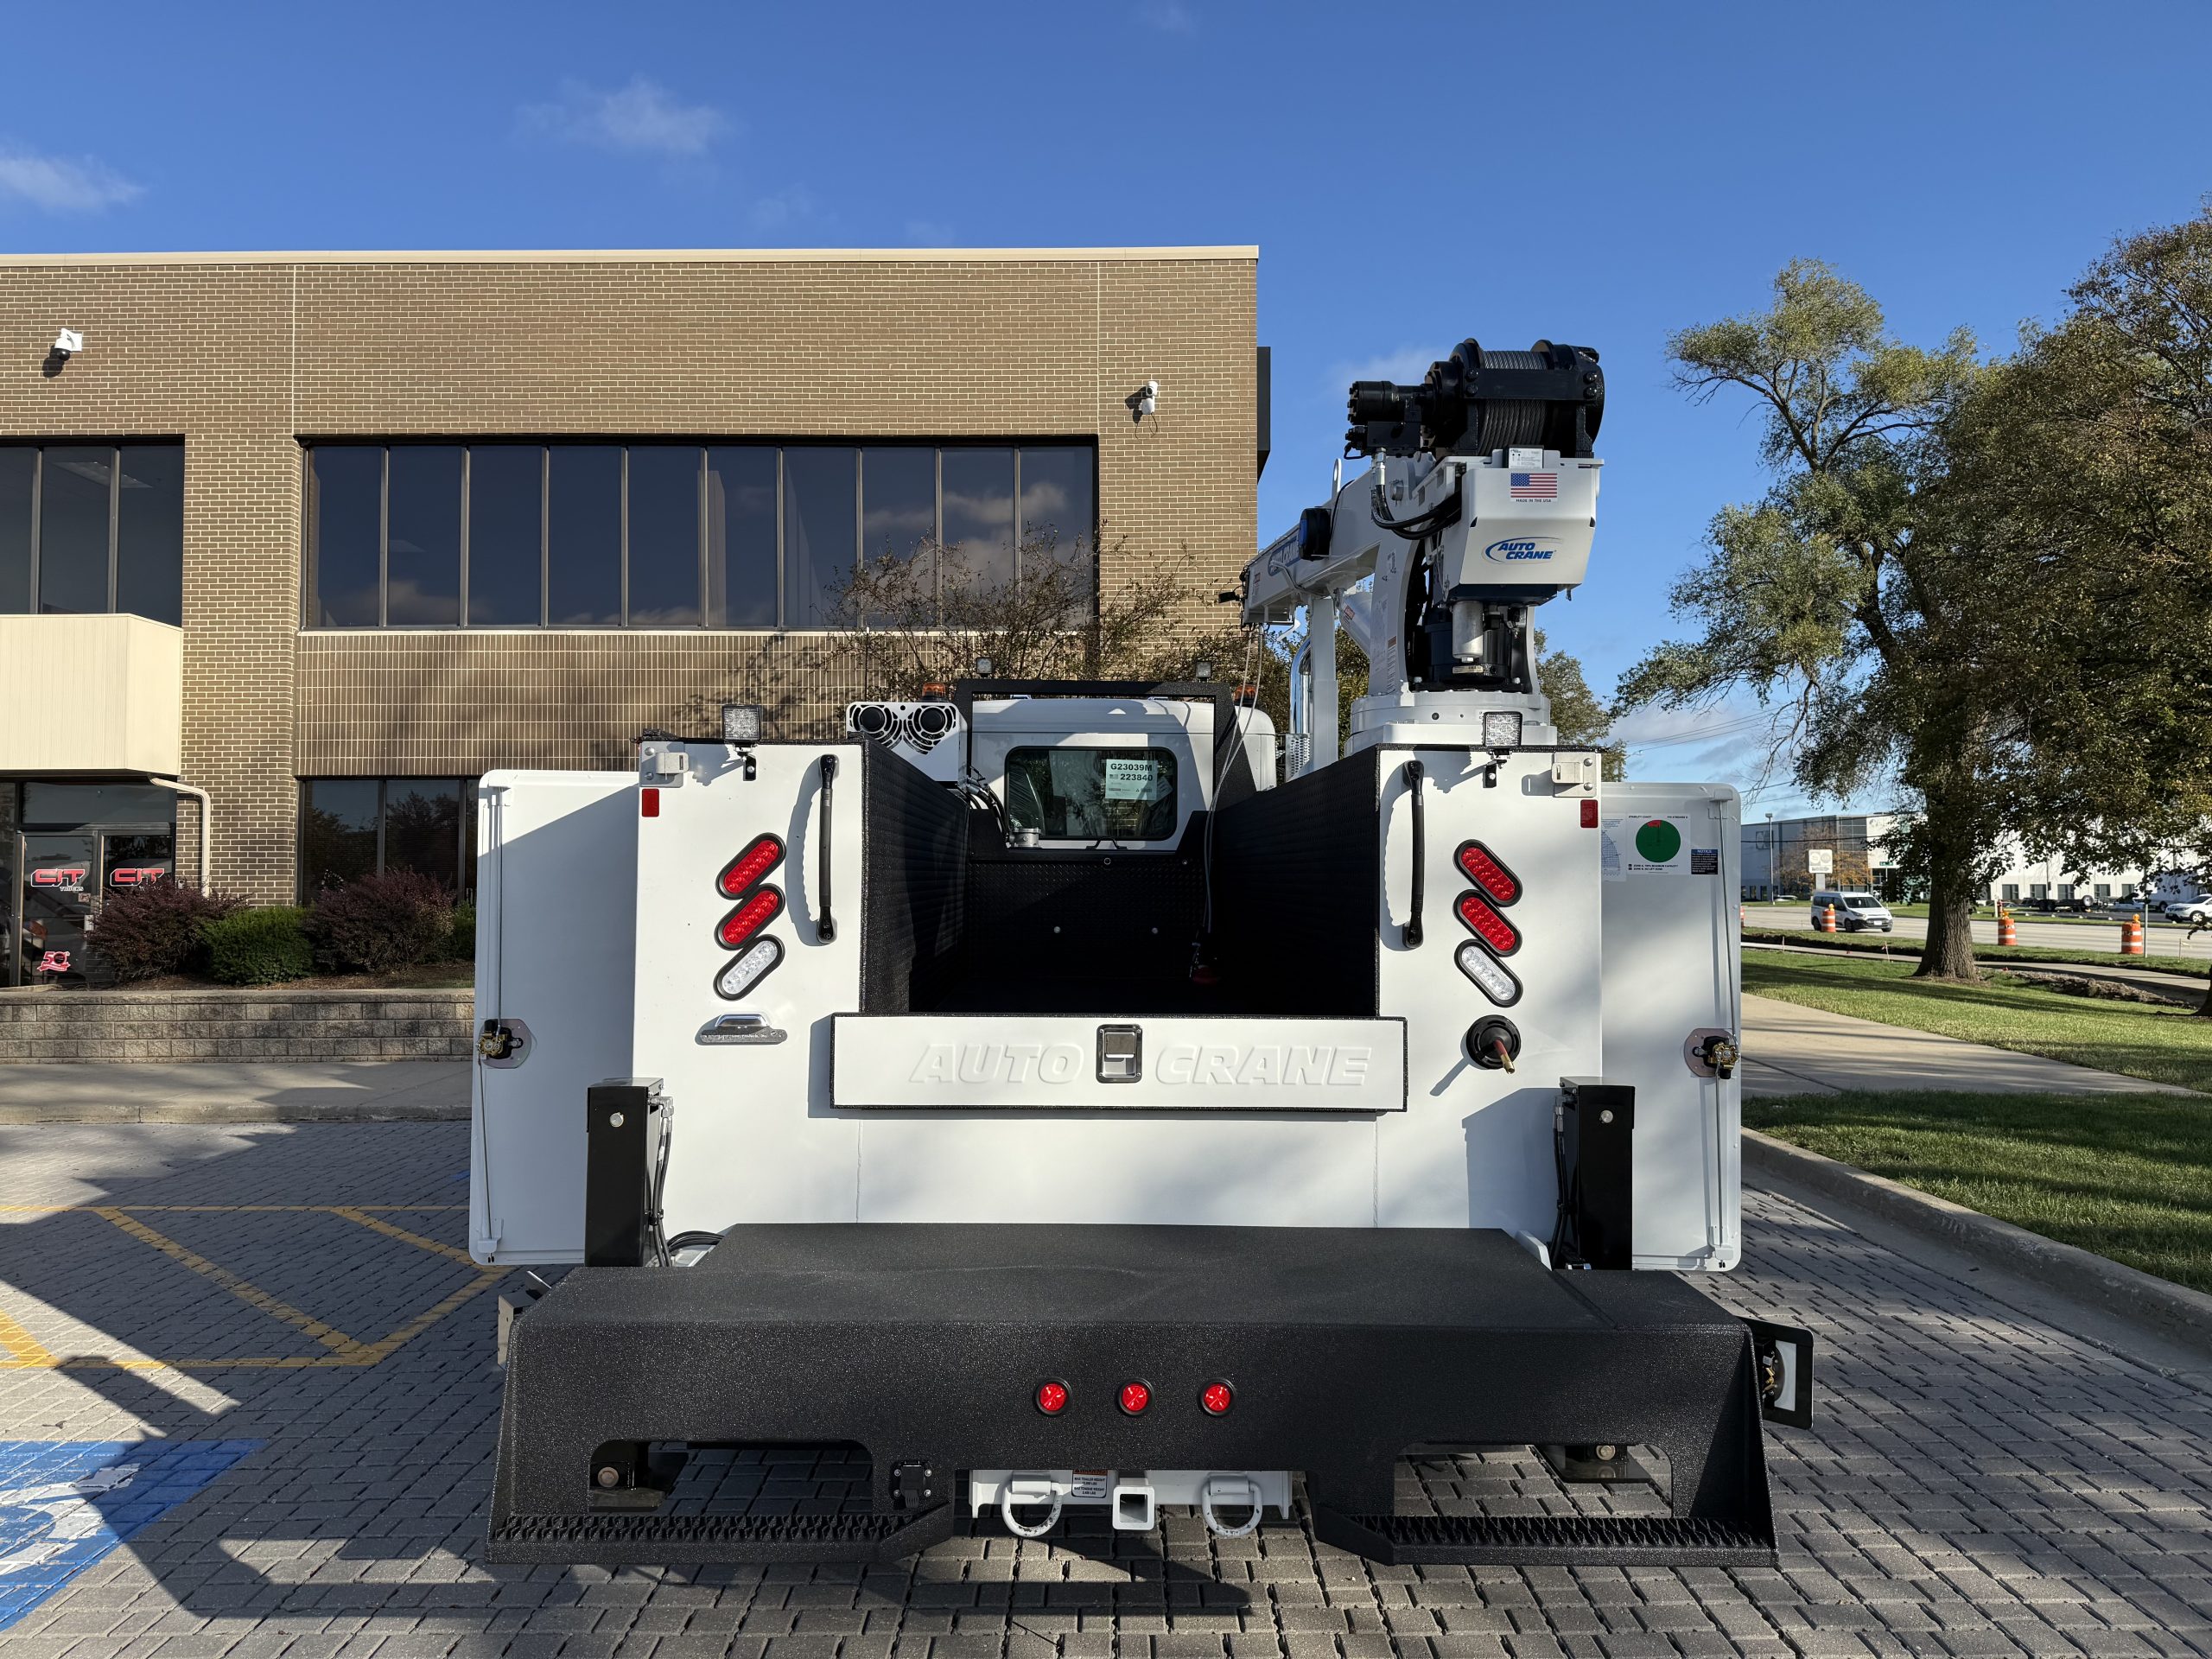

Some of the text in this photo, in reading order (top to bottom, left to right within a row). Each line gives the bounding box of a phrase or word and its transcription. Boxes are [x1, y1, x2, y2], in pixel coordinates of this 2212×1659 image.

[1497, 543, 1535, 551] AUTO
[1506, 551, 1554, 560] CRANE
[1110, 763, 1153, 772] G23039M
[32, 868, 85, 887] CIT
[110, 868, 164, 886] CIT
[43, 951, 67, 965] 50
[908, 1044, 1372, 1086] AUTO CRANE
